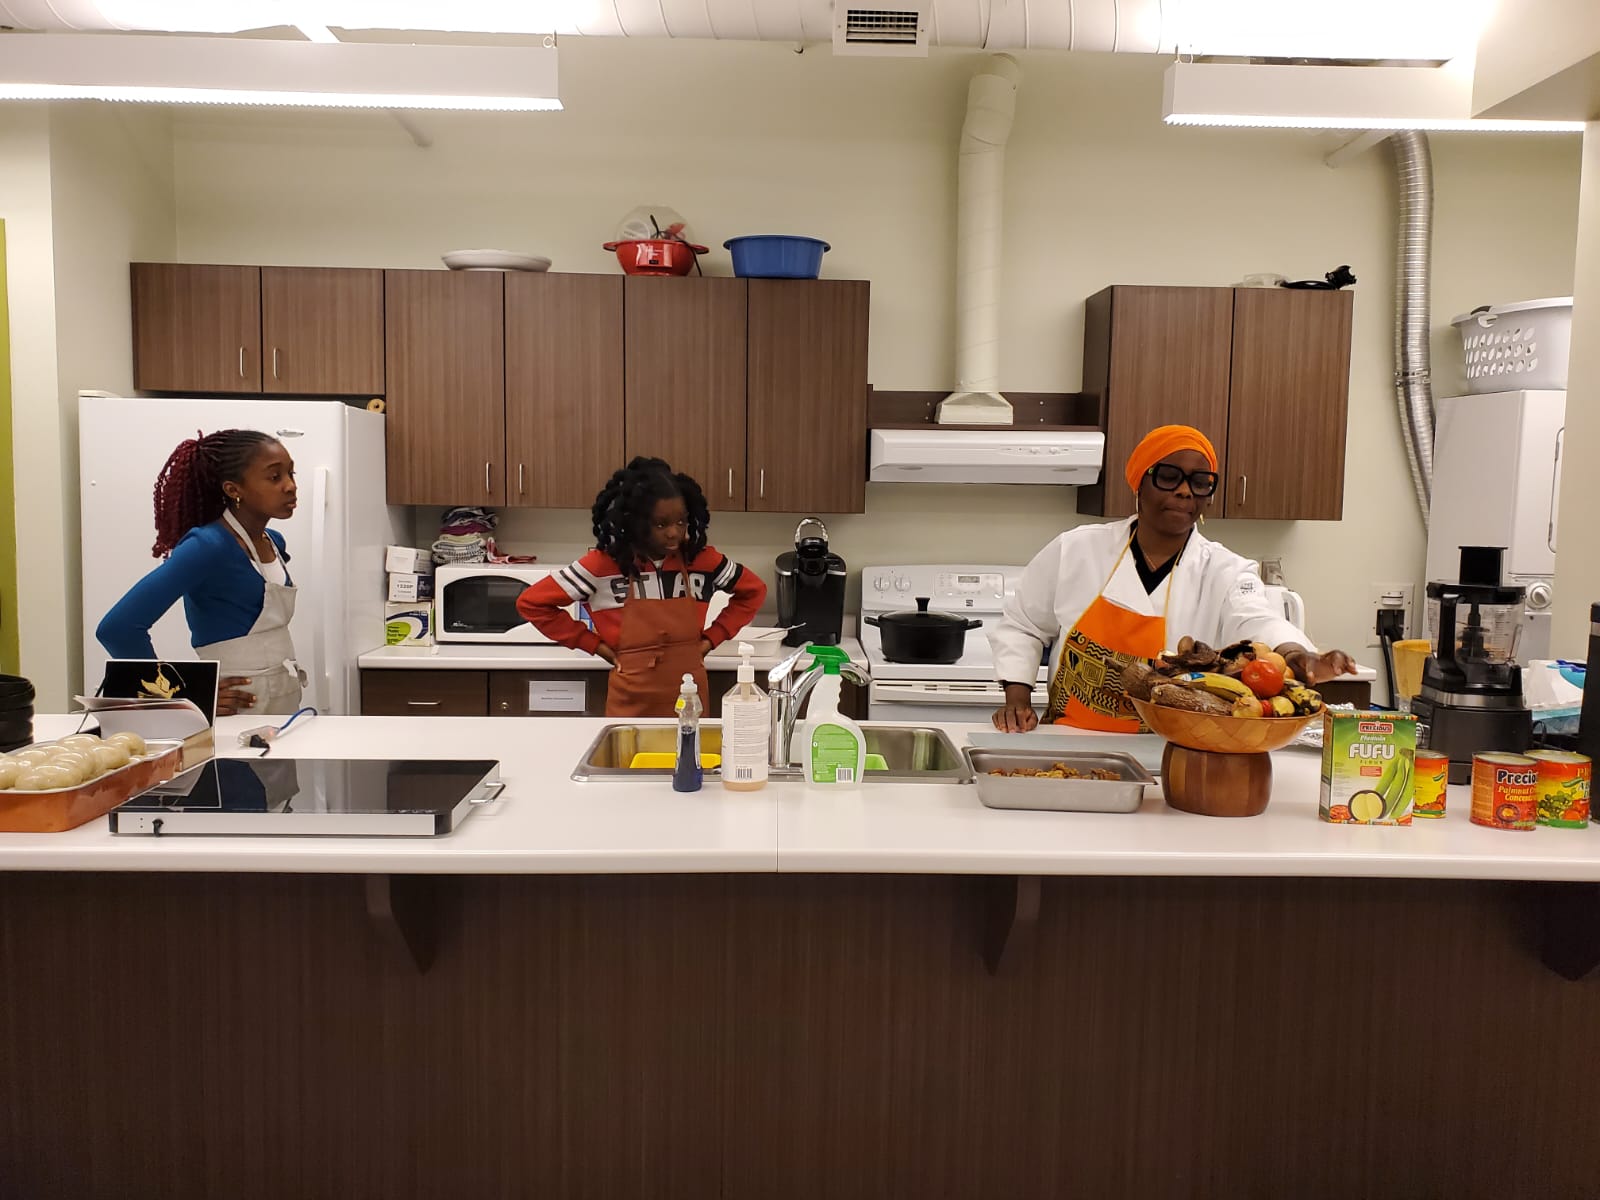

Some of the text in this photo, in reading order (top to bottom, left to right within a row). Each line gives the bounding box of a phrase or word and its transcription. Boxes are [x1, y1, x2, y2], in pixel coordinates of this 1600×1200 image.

[610, 572, 705, 603] STAR
[1349, 743, 1395, 760] FUFU
[1497, 769, 1538, 785] Precio
